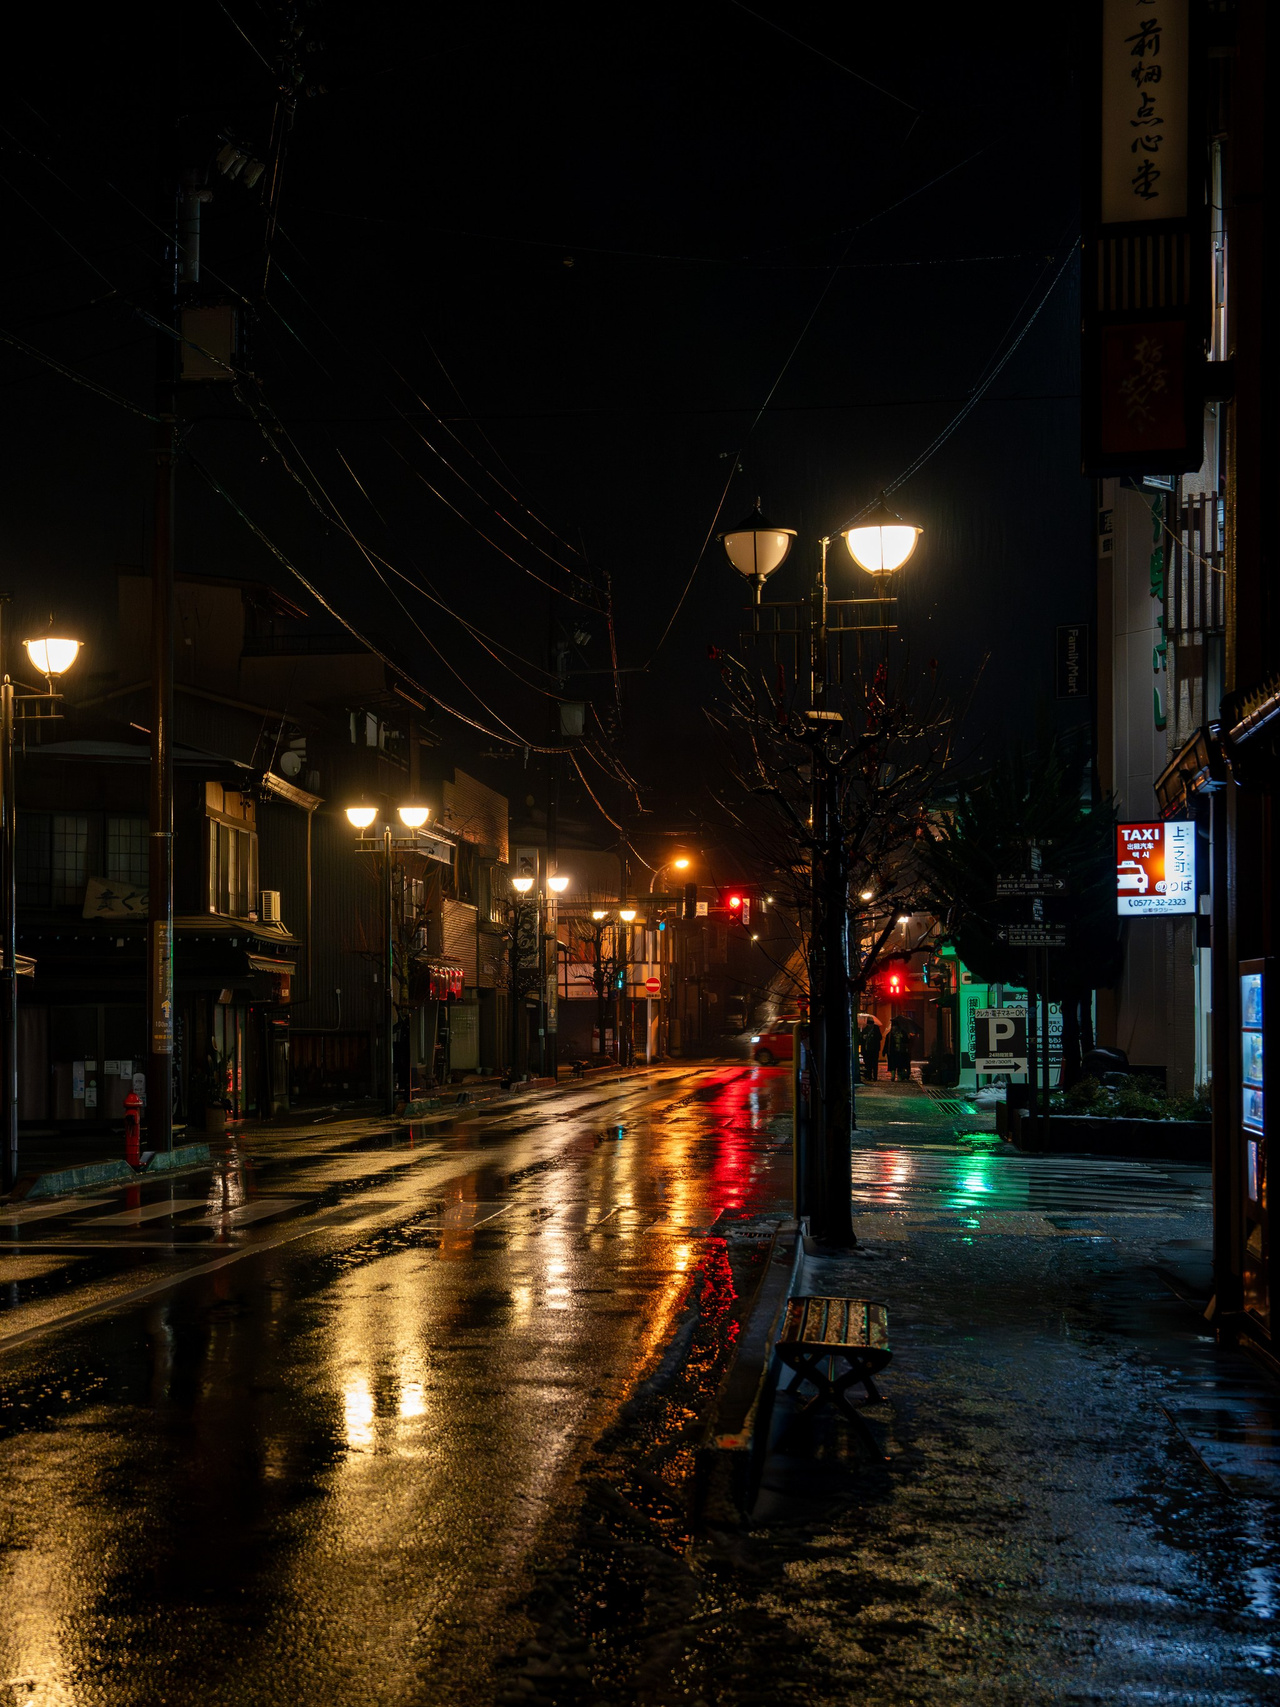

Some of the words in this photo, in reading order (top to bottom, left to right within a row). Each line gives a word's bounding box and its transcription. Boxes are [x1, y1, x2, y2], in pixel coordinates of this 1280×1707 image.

[1124, 0, 1164, 201] 前畑点心堂
[1066, 629, 1079, 695] FamilyMart
[1121, 828, 1160, 841] TAXI
[1172, 826, 1185, 873] 上二之町
[1133, 898, 1187, 907] 0577-32-2323
[1155, 880, 1192, 893] のりば
[988, 1018, 1016, 1052] P
